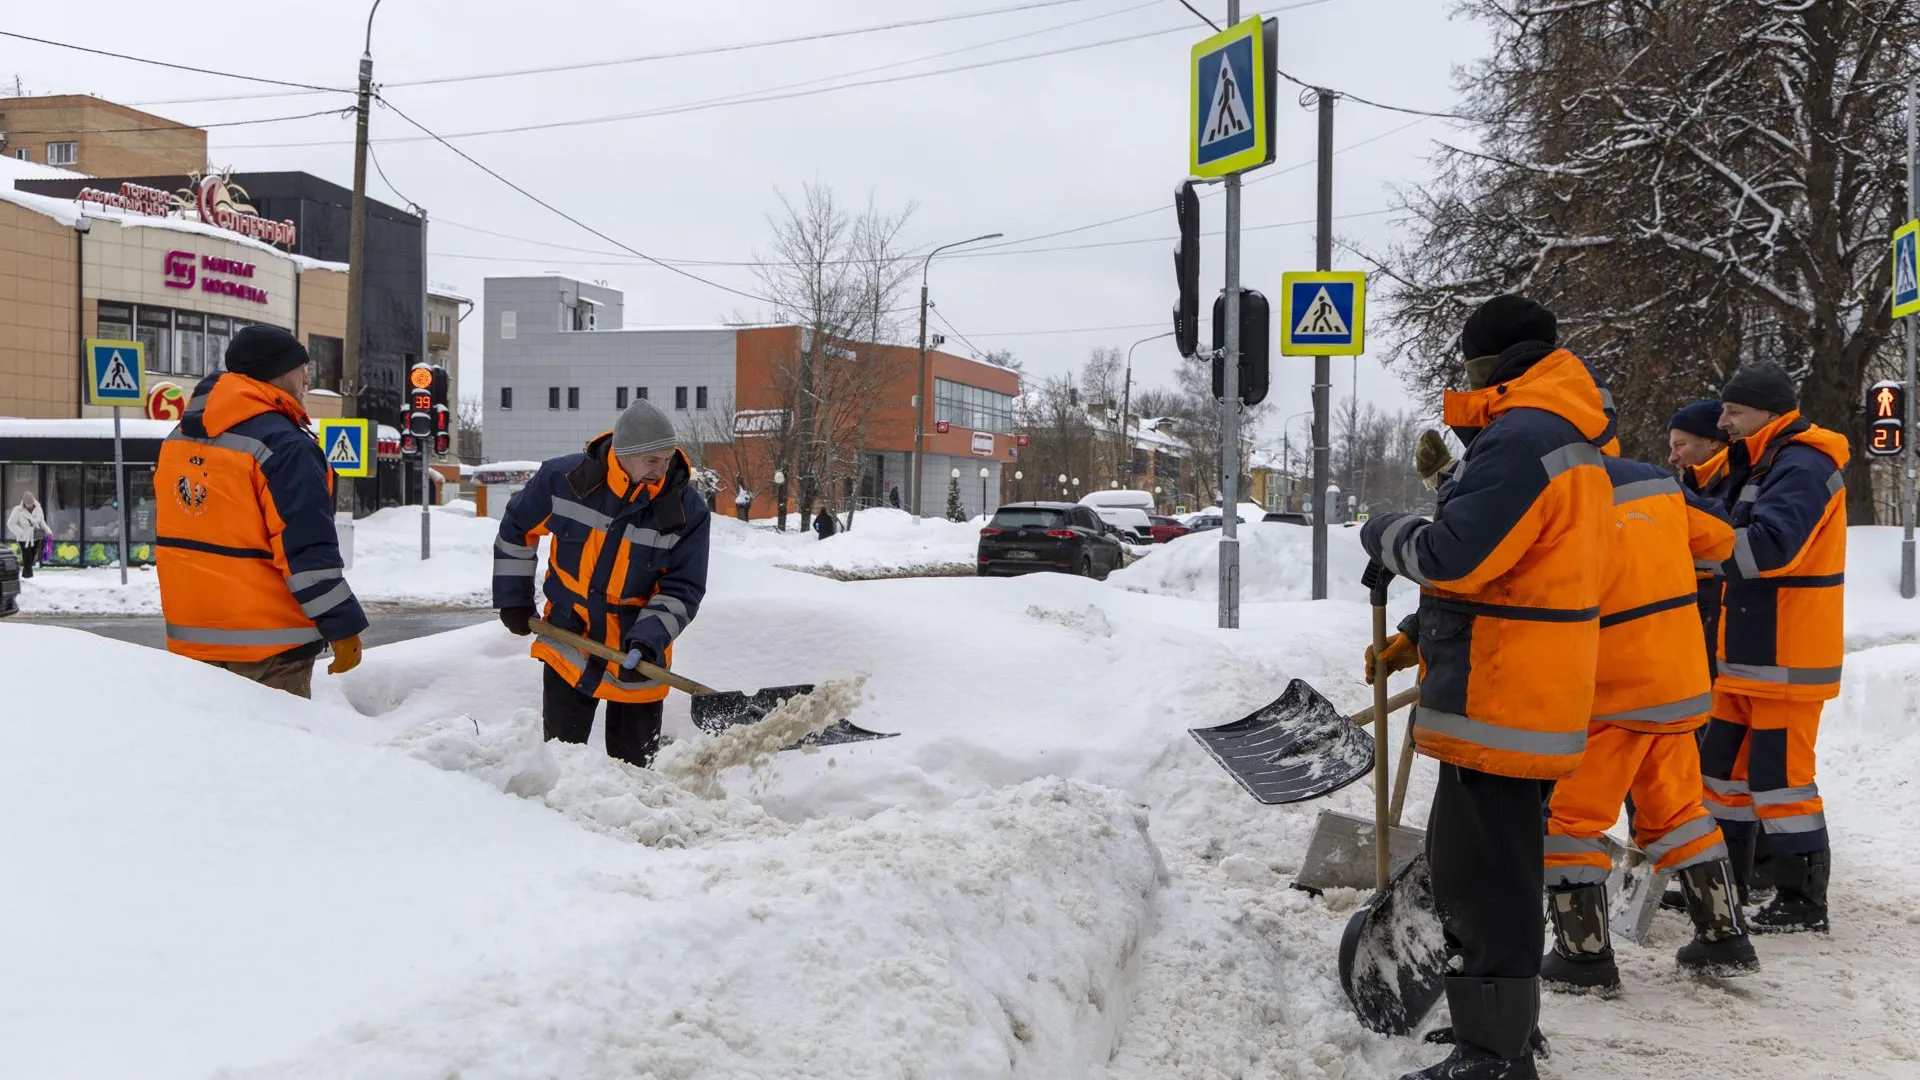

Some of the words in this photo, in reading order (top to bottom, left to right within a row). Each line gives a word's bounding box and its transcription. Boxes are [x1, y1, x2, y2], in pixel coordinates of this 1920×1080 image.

[415, 396, 430, 409] 39
[735, 414, 787, 431] МАГНИ
[1874, 429, 1900, 447] 21
